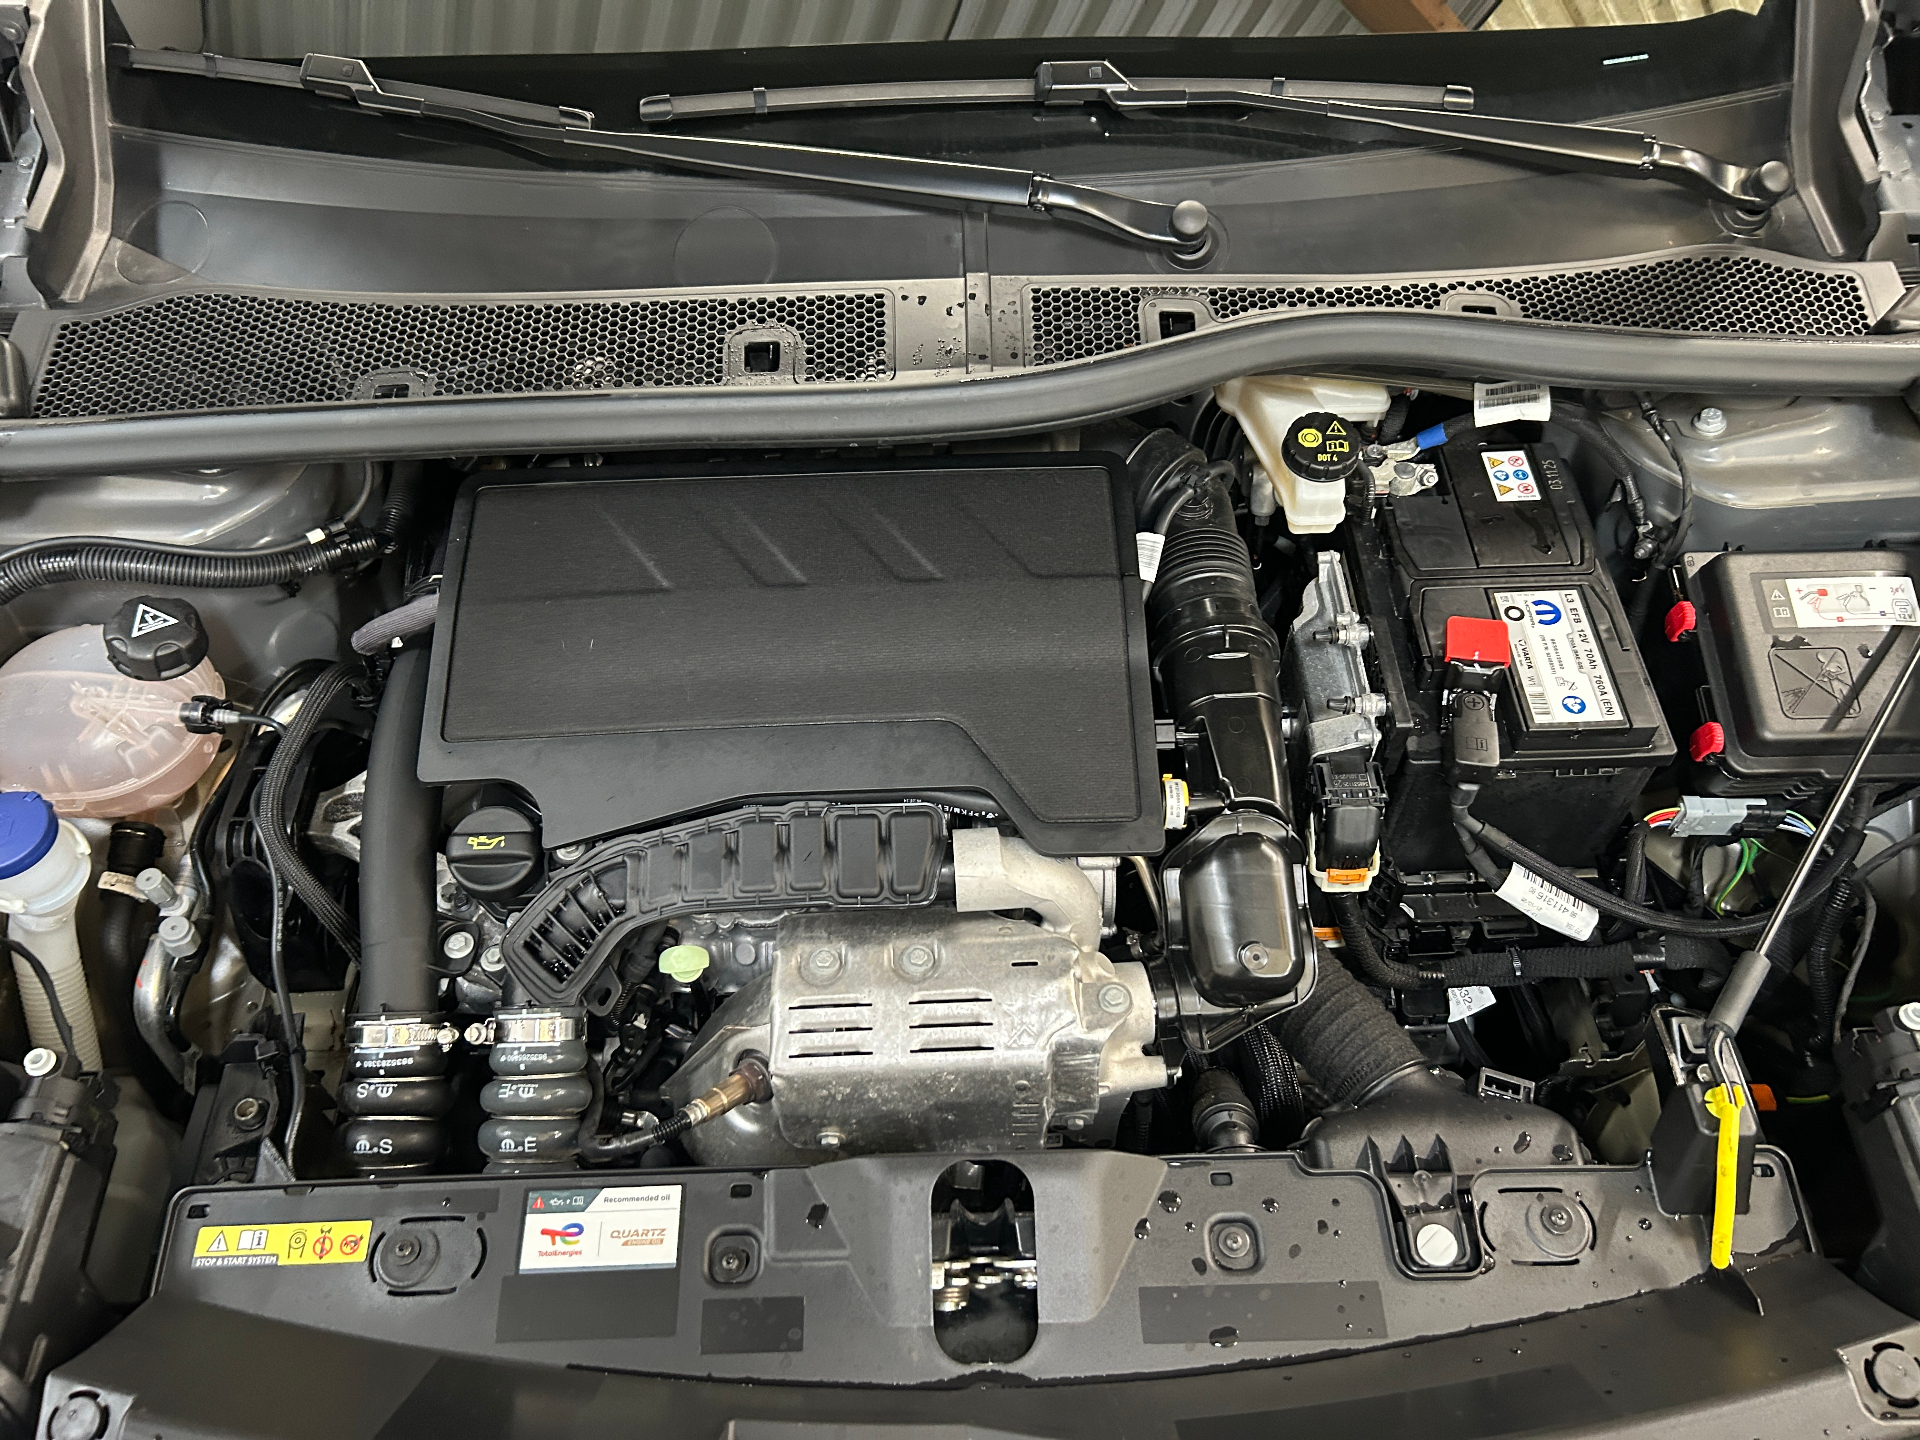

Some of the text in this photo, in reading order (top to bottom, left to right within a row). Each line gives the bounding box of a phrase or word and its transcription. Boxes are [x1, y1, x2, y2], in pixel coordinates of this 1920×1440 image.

[1317, 453, 1338, 462] DOT 4
[1541, 459, 1563, 490] 03.11.25
[1521, 646, 1534, 669] VARTA
[1564, 593, 1615, 715] L3 EFB 12V 70Ah 760A (EN)
[1536, 892, 1569, 914] 411316
[379, 1138, 393, 1154] S
[524, 1137, 538, 1153] E
[603, 1194, 671, 1204] Recommended oil
[610, 1228, 667, 1239] QUARTZ
[223, 1257, 248, 1265] START
[248, 1255, 277, 1264] SYSTEM
[537, 1250, 583, 1258] TotalEnergies
